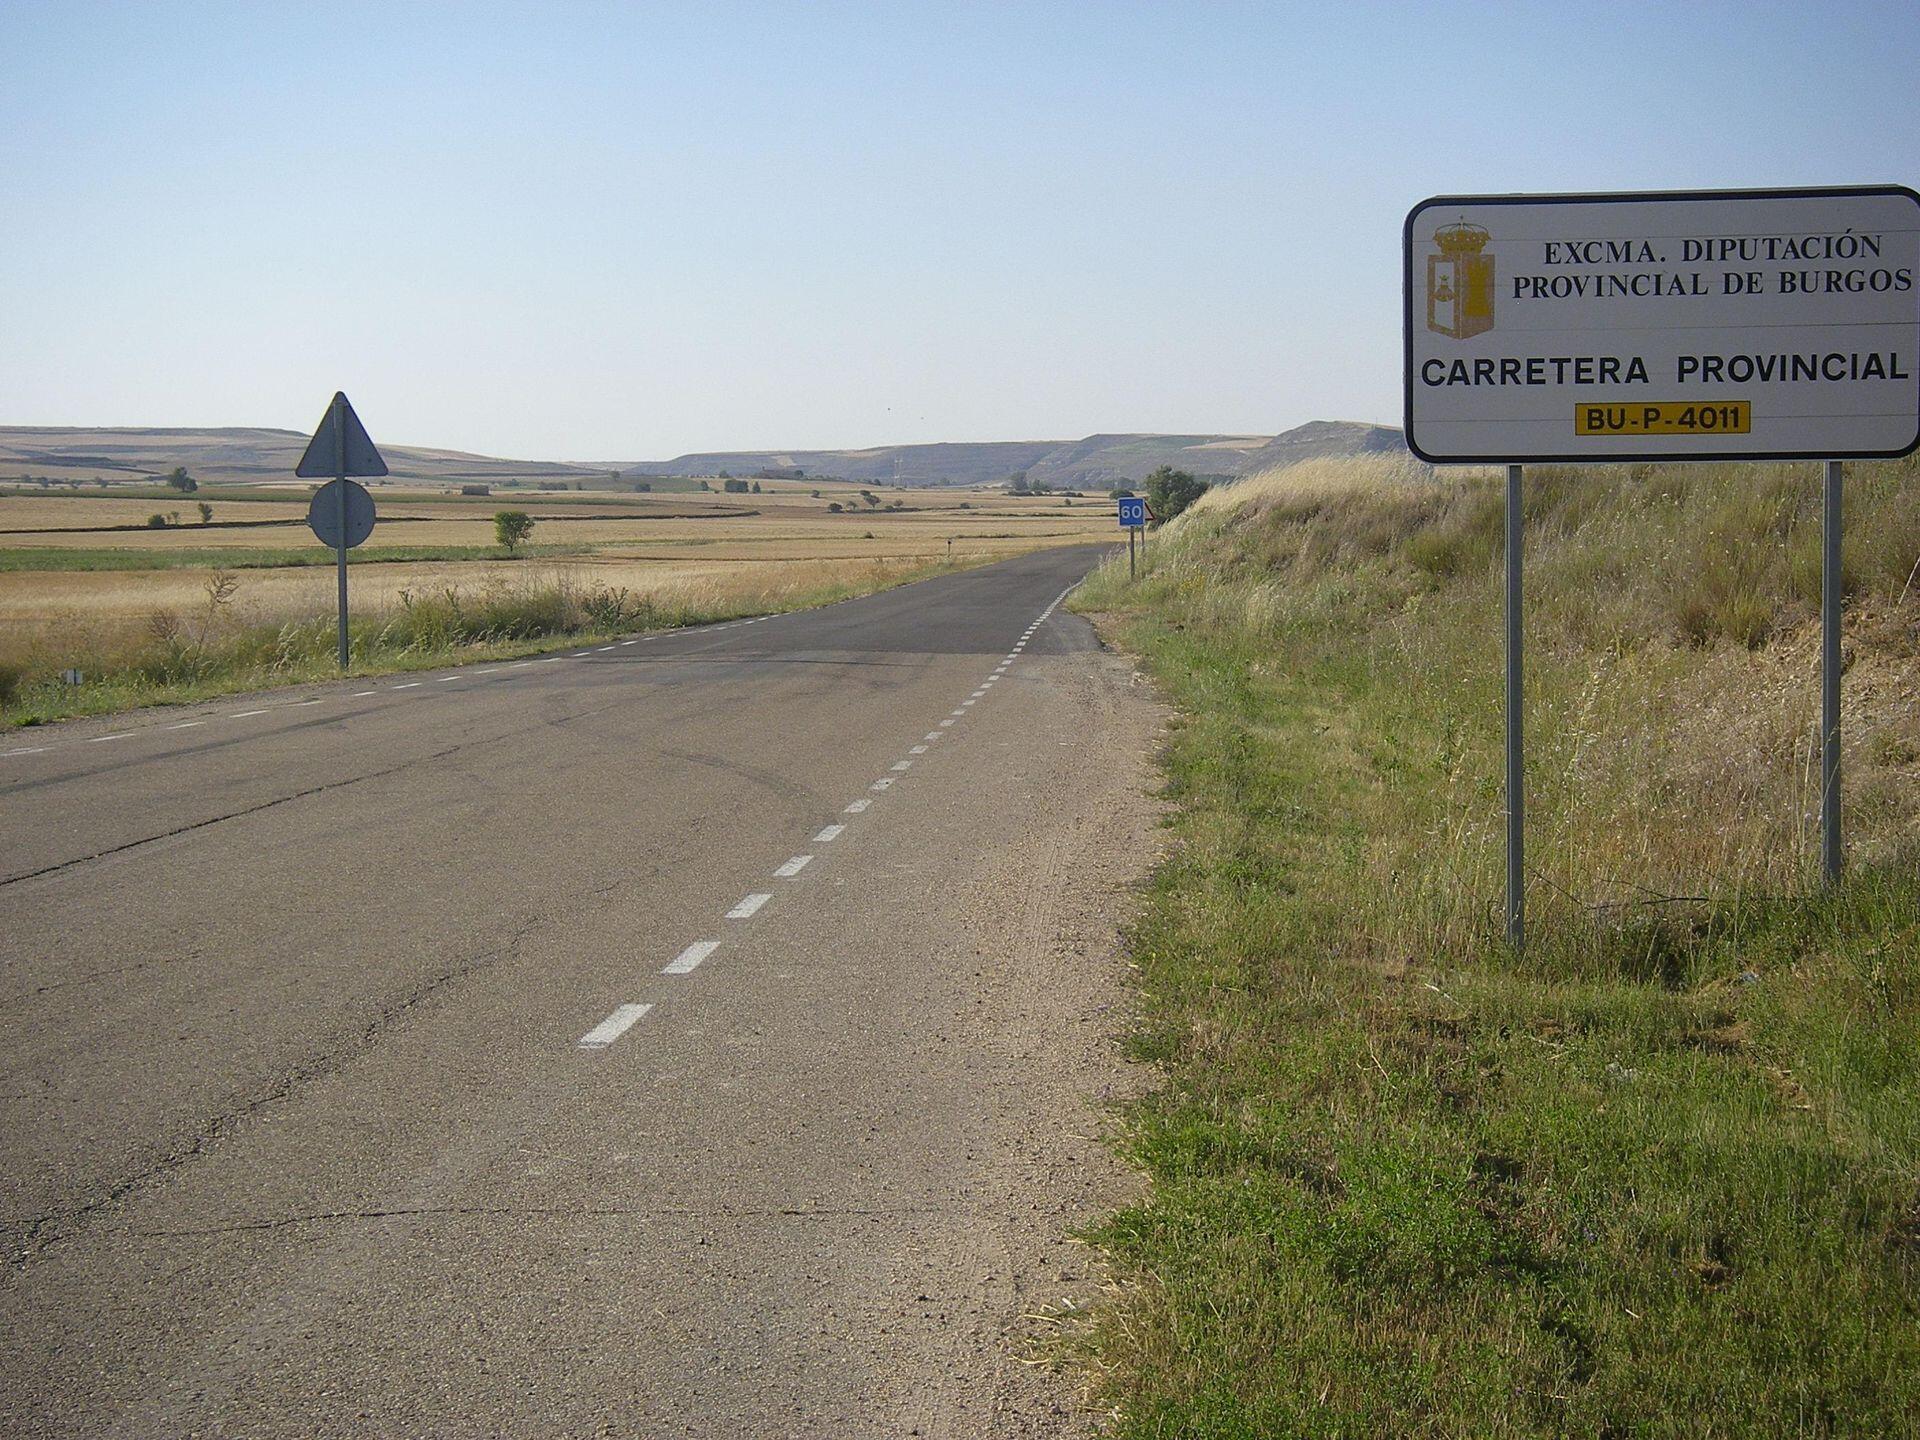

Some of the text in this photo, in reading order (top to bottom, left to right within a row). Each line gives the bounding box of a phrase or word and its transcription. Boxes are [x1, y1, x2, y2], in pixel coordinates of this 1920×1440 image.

[1543, 228, 1882, 265] EXCMA. DIPUTACIÓN
[1512, 267, 1912, 299] PROVINCIAL DE BURGOS
[1421, 352, 1909, 387] CARRETERA PROVINCIAL
[1586, 406, 1740, 431] BU-P-4011
[1121, 505, 1142, 519] 60
